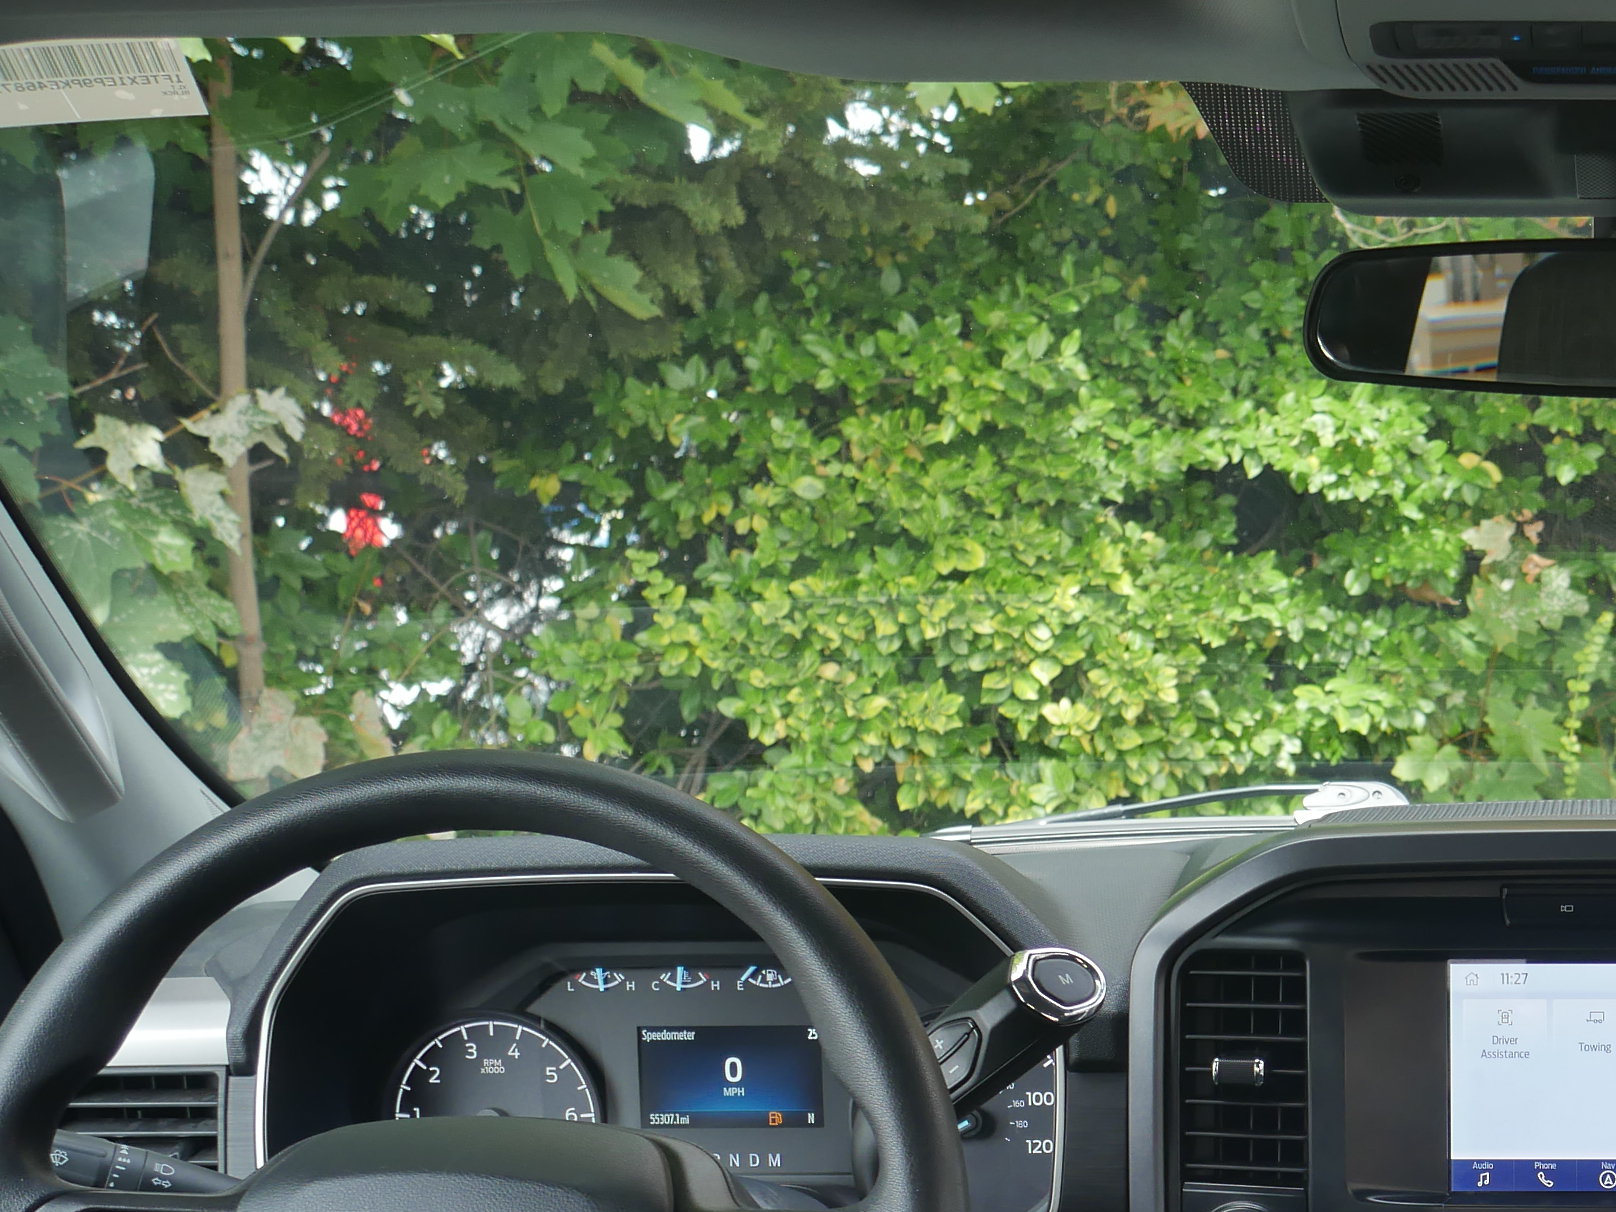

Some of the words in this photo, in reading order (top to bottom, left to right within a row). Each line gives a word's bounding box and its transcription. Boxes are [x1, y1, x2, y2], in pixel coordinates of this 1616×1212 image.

[1499, 972, 1528, 985] 11:27
[566, 981, 574, 991] L
[626, 981, 635, 991] H
[651, 981, 660, 991] C
[711, 981, 720, 991] H
[736, 980, 744, 991] E
[641, 1029, 696, 1041] Speedometer
[1492, 1035, 1518, 1046] Driver
[465, 1043, 477, 1059] 3
[507, 1043, 520, 1059] 4
[1578, 1042, 1612, 1053] Towing
[1480, 1048, 1530, 1060] Assistance
[483, 1059, 502, 1067] RPM
[428, 1067, 441, 1083] 2
[545, 1067, 558, 1083] 5
[724, 1056, 743, 1083] 0
[723, 1087, 745, 1097] MPH
[1025, 1091, 1055, 1106] 100
[565, 1107, 578, 1121] 6
[807, 1113, 815, 1124] N
[1025, 1139, 1054, 1154] 120
[729, 1153, 740, 1167] N
[749, 1153, 760, 1167] D
[768, 1153, 781, 1167] M
[1472, 1161, 1494, 1170] Audio
[1534, 1161, 1557, 1170] Phone
[1601, 1161, 1616, 1170] Nav
